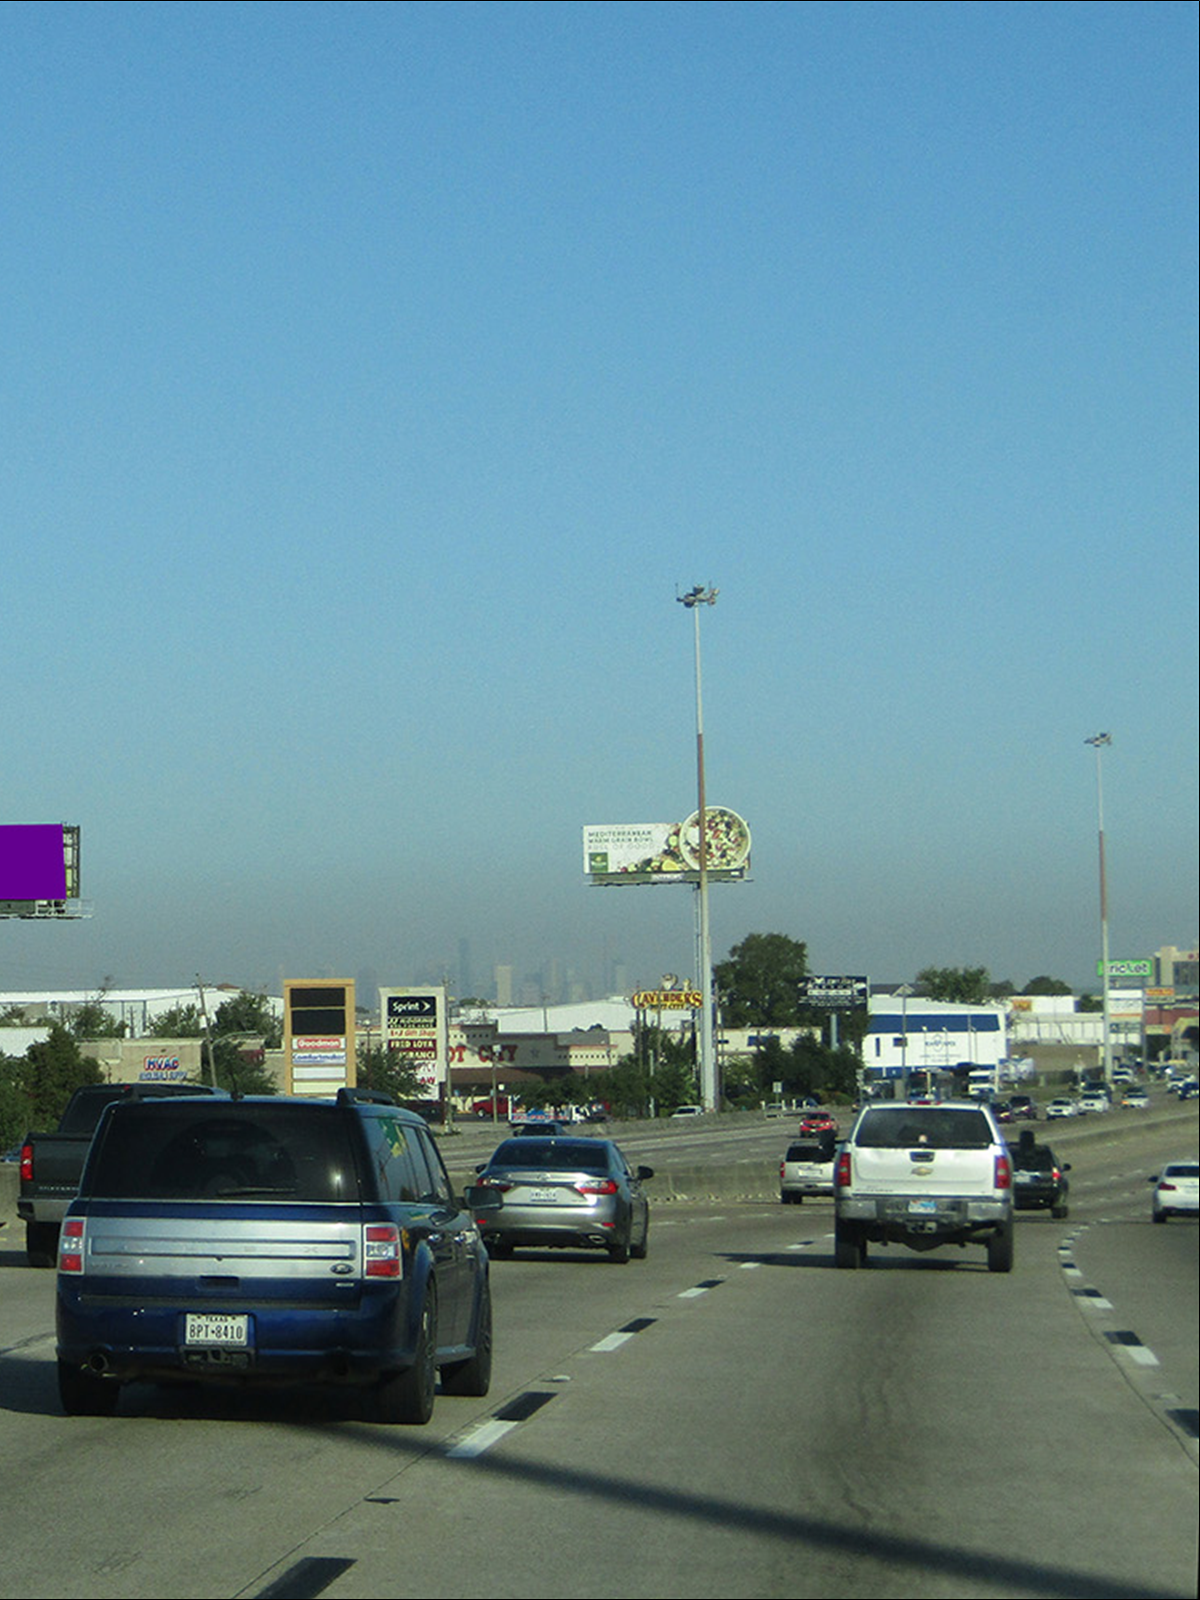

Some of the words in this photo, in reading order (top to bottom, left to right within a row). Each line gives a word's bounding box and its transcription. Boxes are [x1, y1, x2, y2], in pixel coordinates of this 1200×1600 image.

[588, 830, 652, 838] MEDITERRANEAN
[1106, 963, 1148, 974] ricket
[392, 1001, 420, 1013] Sprint
[298, 1039, 340, 1048] Goodman
[390, 1040, 411, 1049] FRED
[413, 1040, 434, 1049] LOYA
[143, 1054, 180, 1071] HVAC
